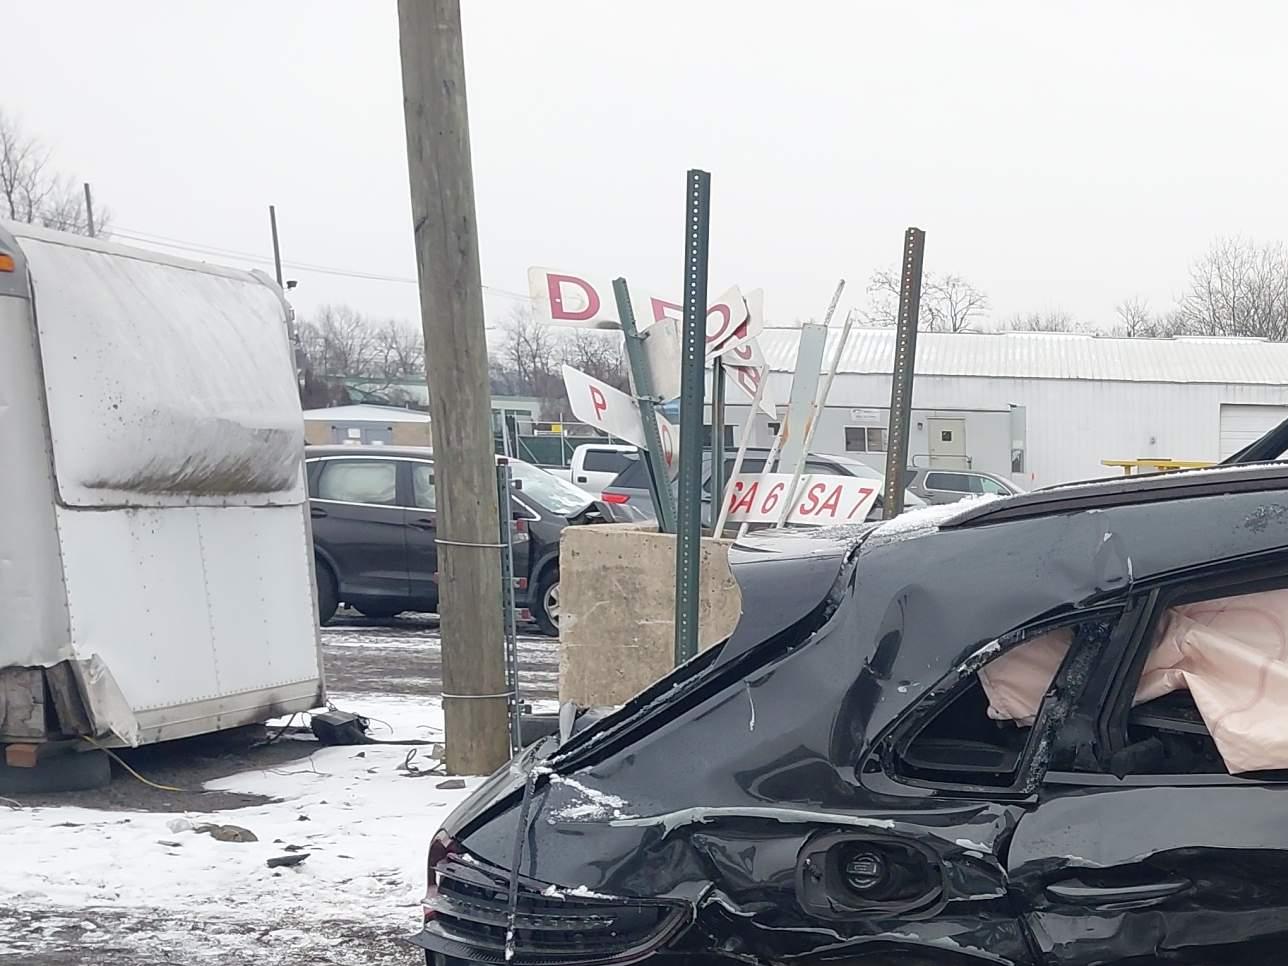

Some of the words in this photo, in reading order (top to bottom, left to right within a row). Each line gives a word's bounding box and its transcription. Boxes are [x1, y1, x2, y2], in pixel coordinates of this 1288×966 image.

[546, 273, 601, 321] D
[589, 384, 607, 421] P
[760, 482, 785, 514] 6
[799, 482, 844, 517] SA
[847, 487, 874, 519] 7
